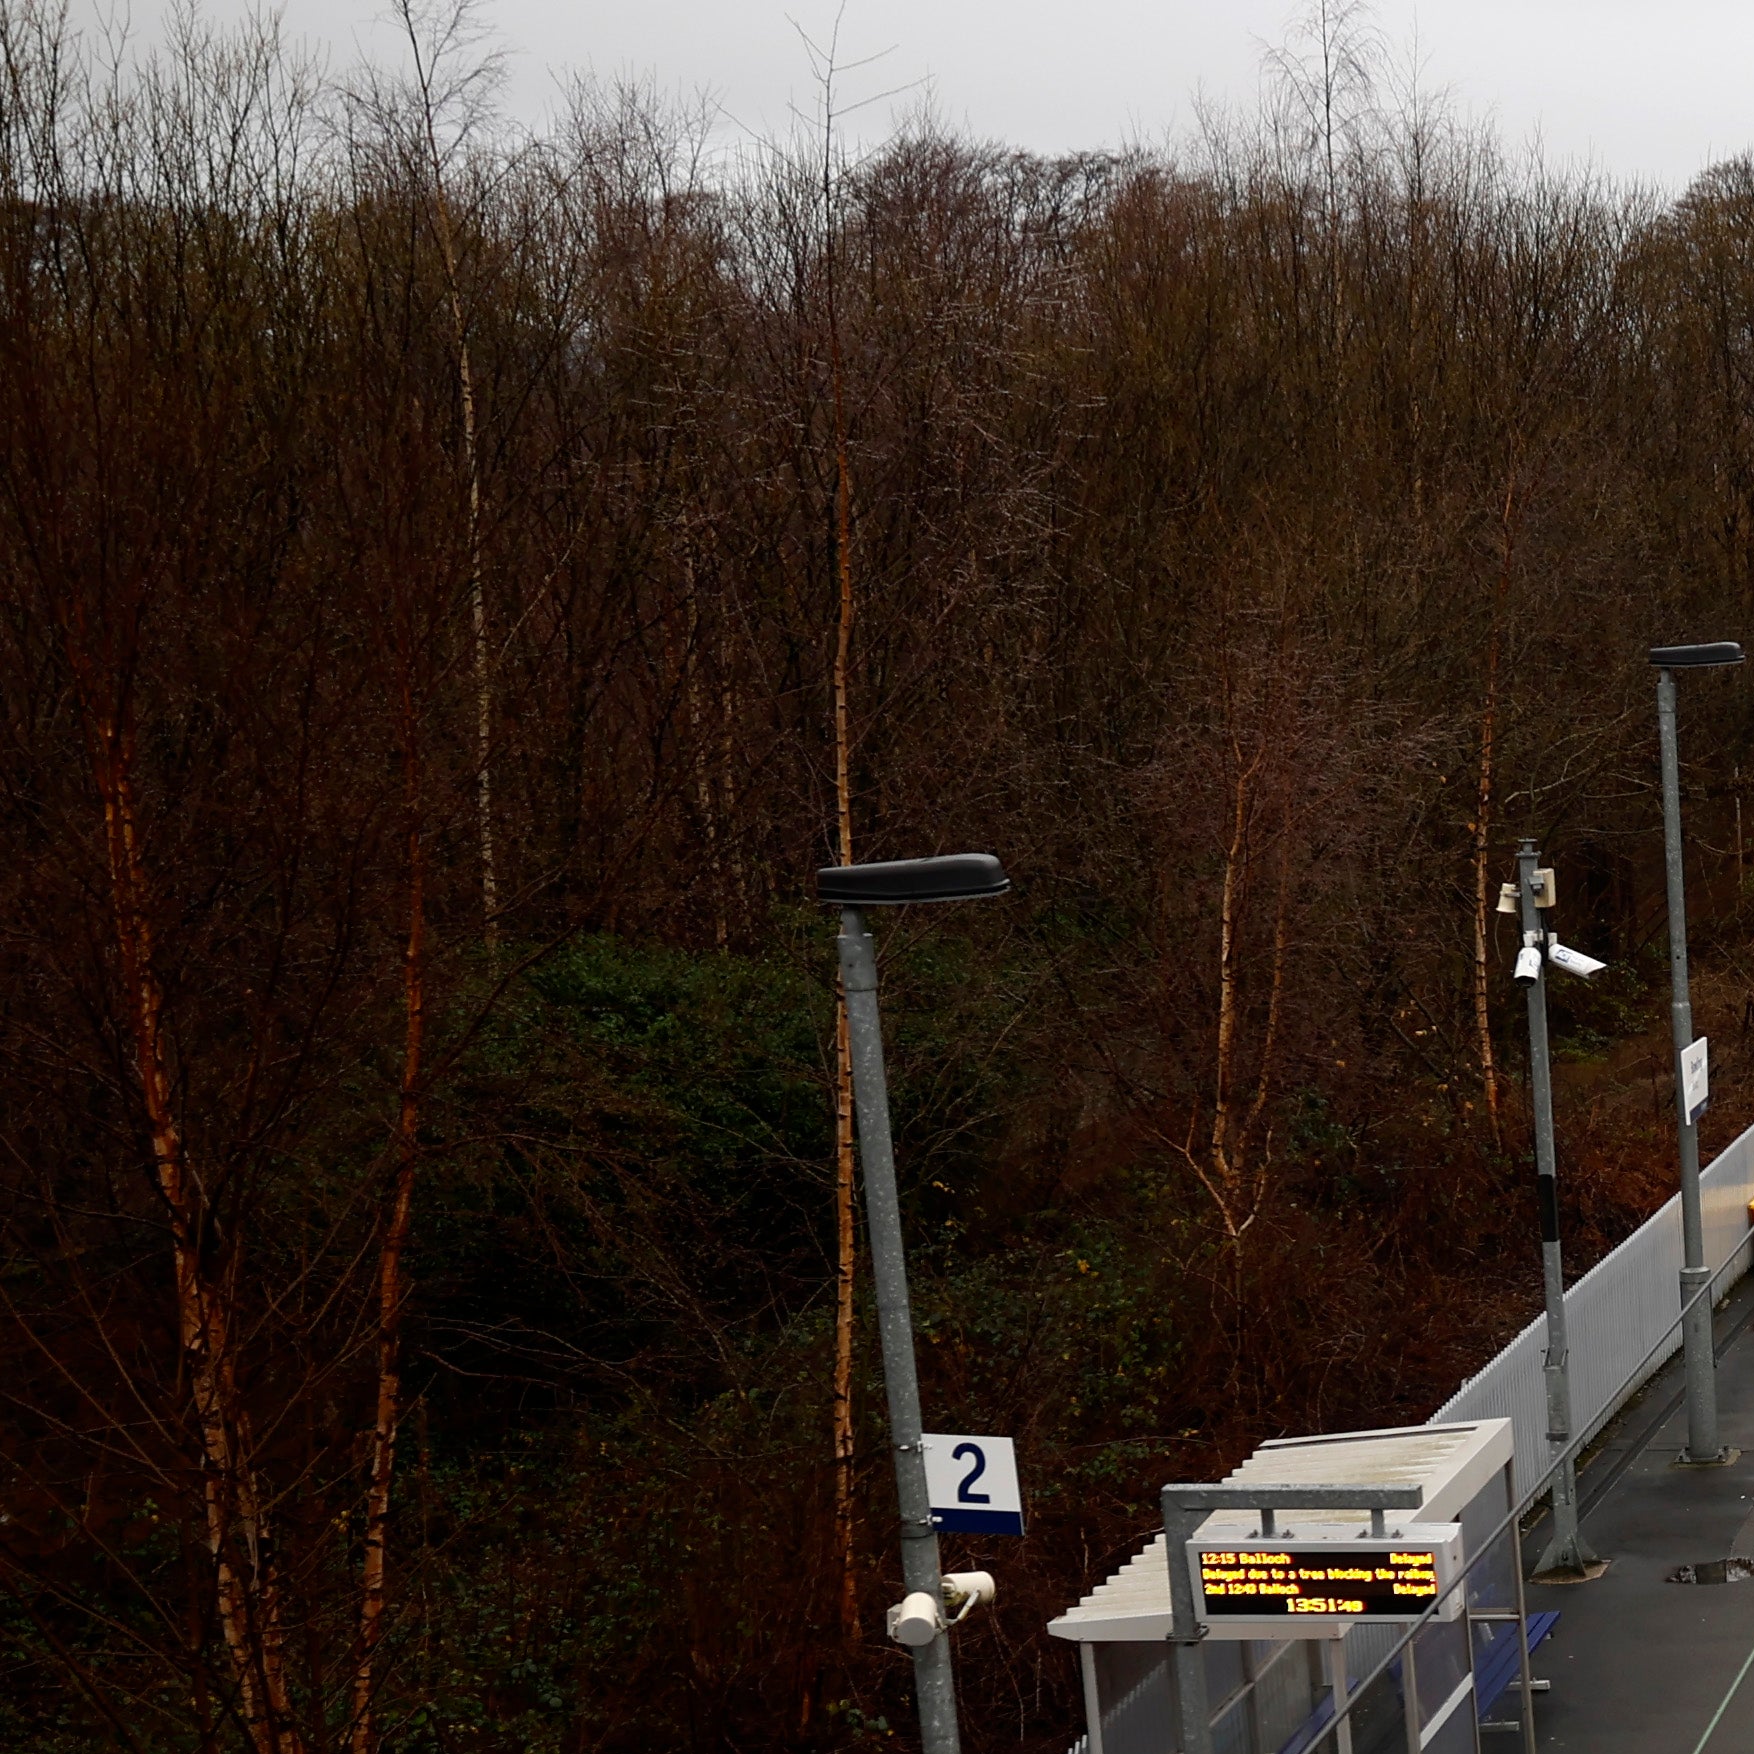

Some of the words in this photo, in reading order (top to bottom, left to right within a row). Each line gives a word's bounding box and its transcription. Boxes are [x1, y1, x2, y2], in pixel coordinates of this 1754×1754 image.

[952, 1442, 991, 1504] 2
[1202, 1552, 1236, 1564] 12:15
[1239, 1552, 1292, 1564] Balloch
[1390, 1552, 1434, 1566] Delayed
[1202, 1569, 1246, 1582] Delayed
[1248, 1568, 1269, 1580] due
[1271, 1569, 1286, 1580] to
[1288, 1571, 1296, 1580] a
[1298, 1569, 1326, 1580] tree
[1327, 1568, 1373, 1582] blocking
[1375, 1568, 1396, 1580] the
[1204, 1584, 1226, 1595] 2nd
[1259, 1584, 1300, 1595] Balloch
[1393, 1584, 1436, 1596] Delayed
